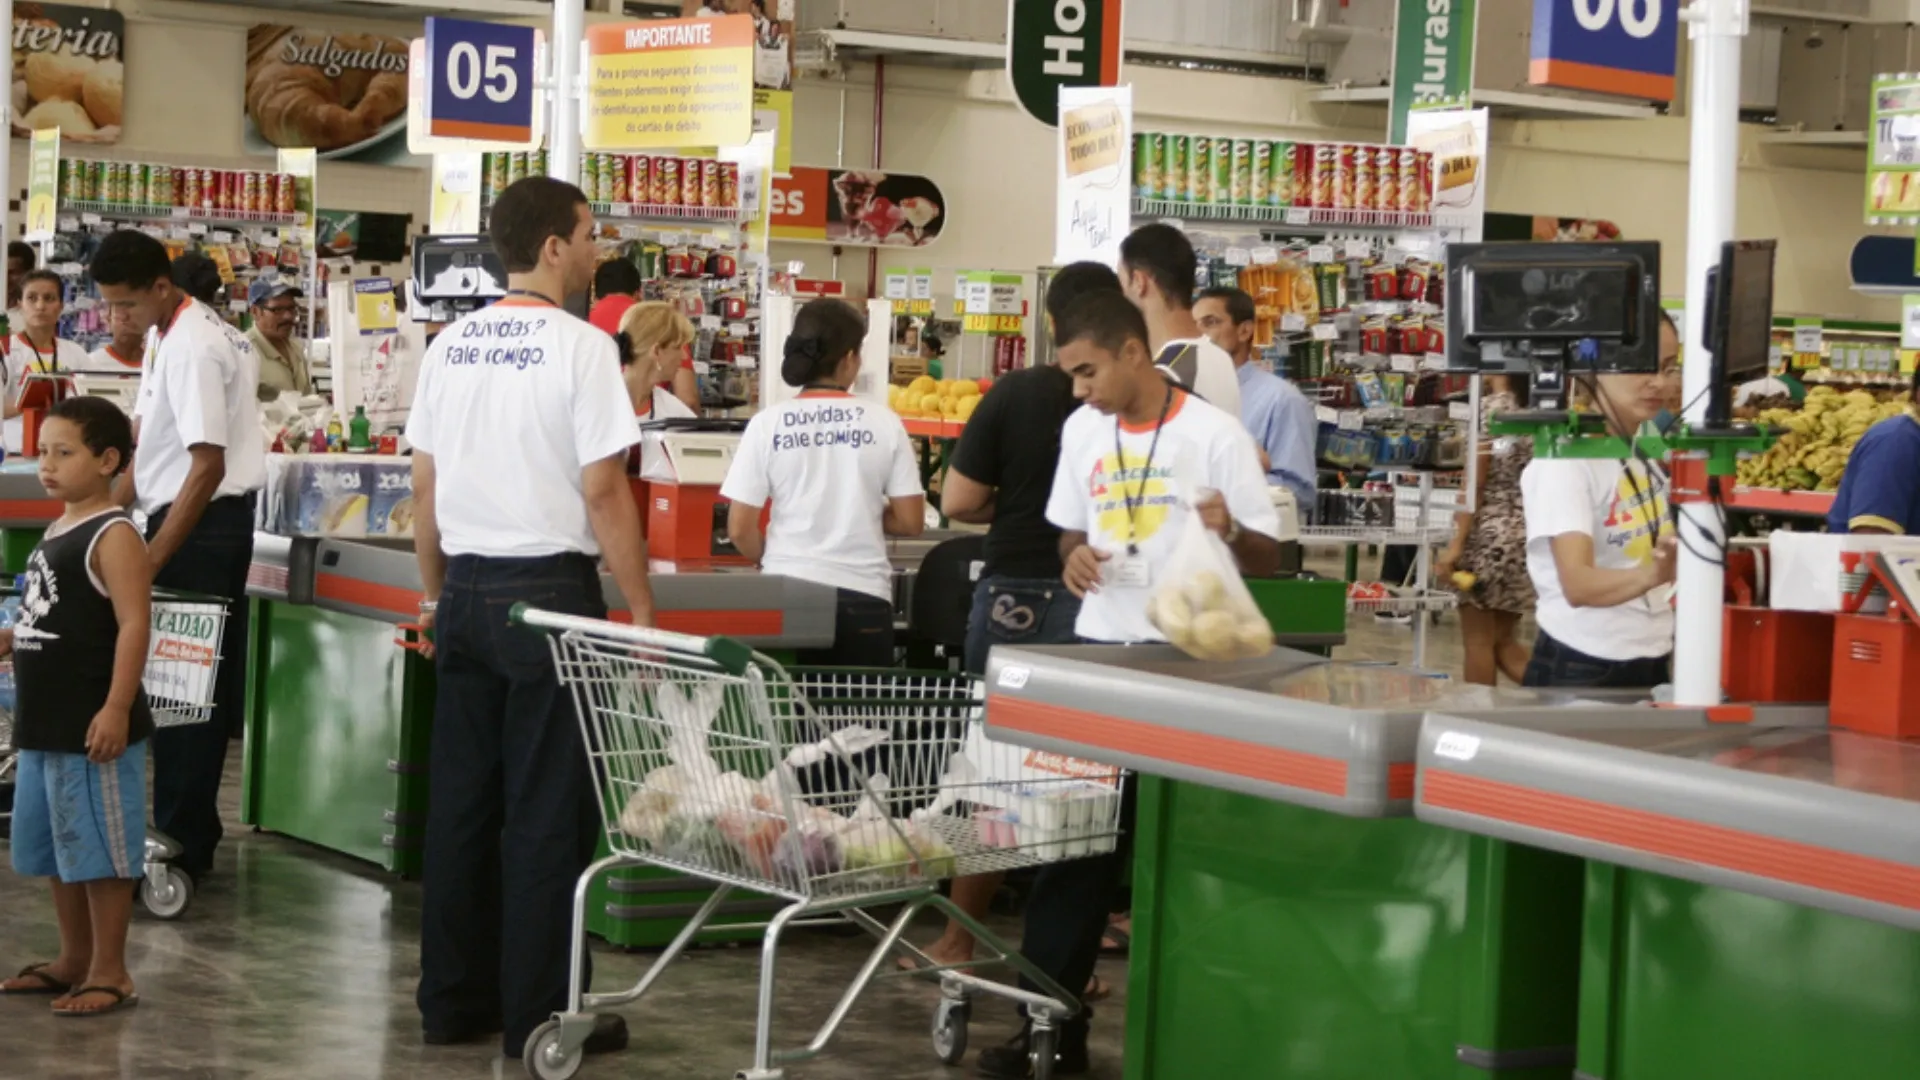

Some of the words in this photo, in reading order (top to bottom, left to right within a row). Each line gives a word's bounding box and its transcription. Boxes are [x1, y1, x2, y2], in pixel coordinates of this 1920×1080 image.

[625, 23, 712, 49] IMPORTANTE
[281, 35, 408, 77] Salgados
[447, 41, 518, 103] 05
[771, 188, 805, 216] es
[462, 315, 546, 338] Dúvidas?
[783, 405, 865, 427] Dúvidas?
[773, 432, 810, 451] Fale
